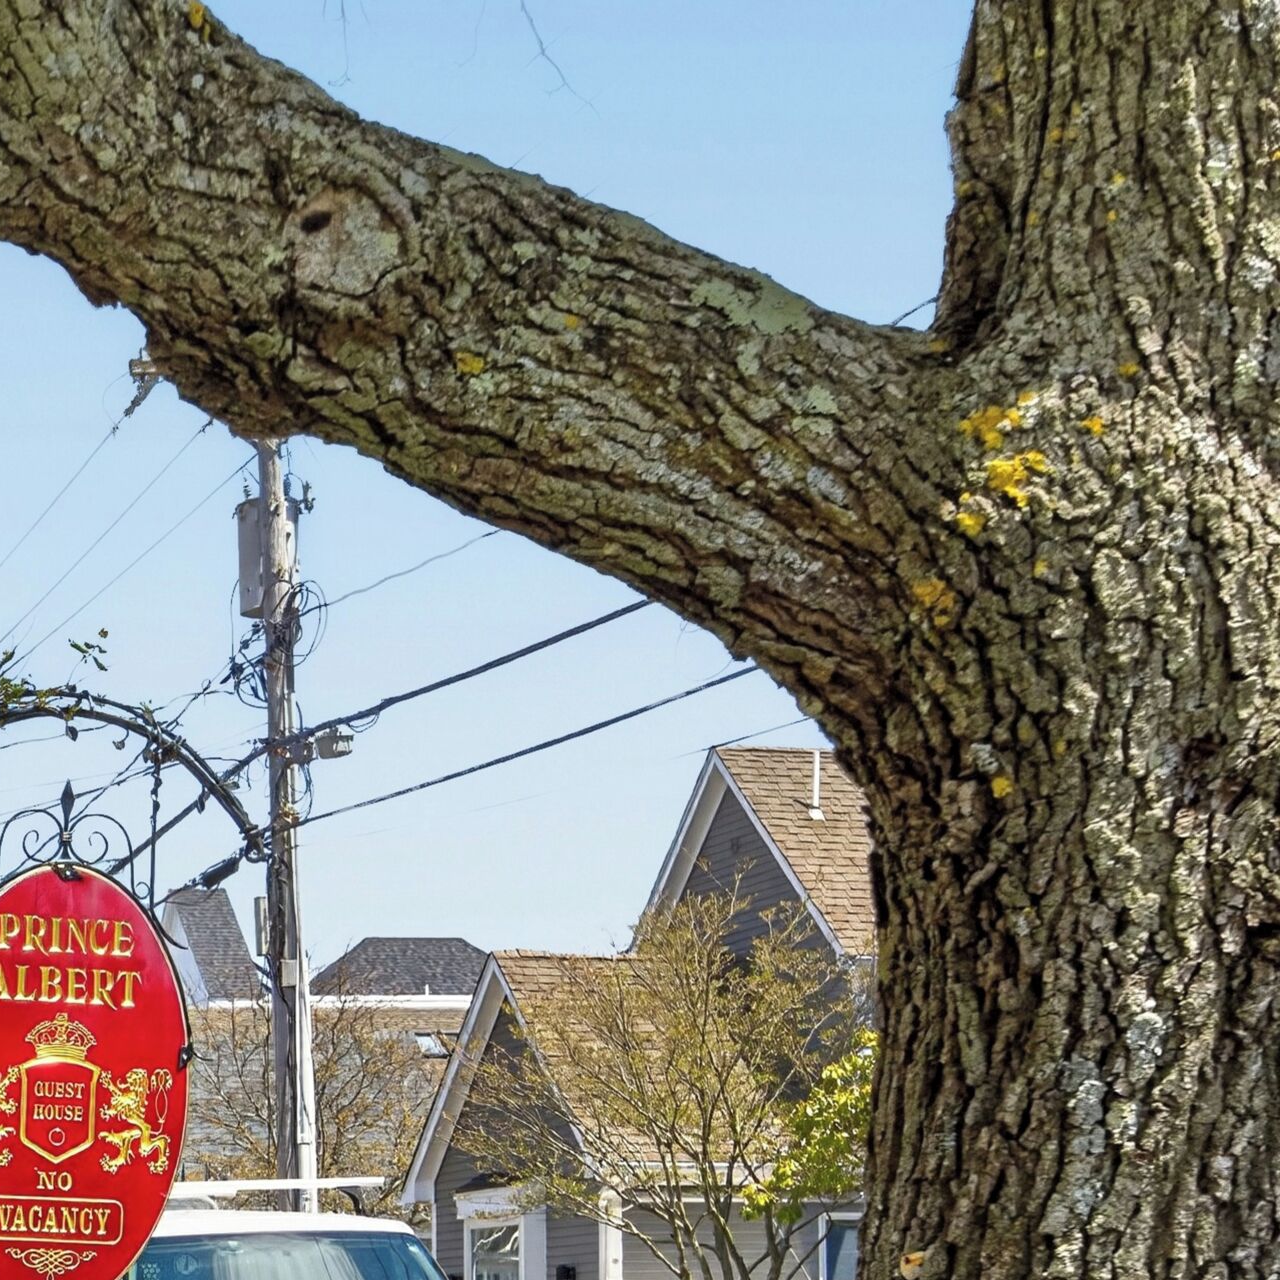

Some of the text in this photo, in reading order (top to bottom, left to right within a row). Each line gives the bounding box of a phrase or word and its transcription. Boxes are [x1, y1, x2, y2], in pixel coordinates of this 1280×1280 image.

[34, 1081, 85, 1099] GUEST
[33, 1104, 83, 1121] HOUSE
[36, 1171, 72, 1191] NO
